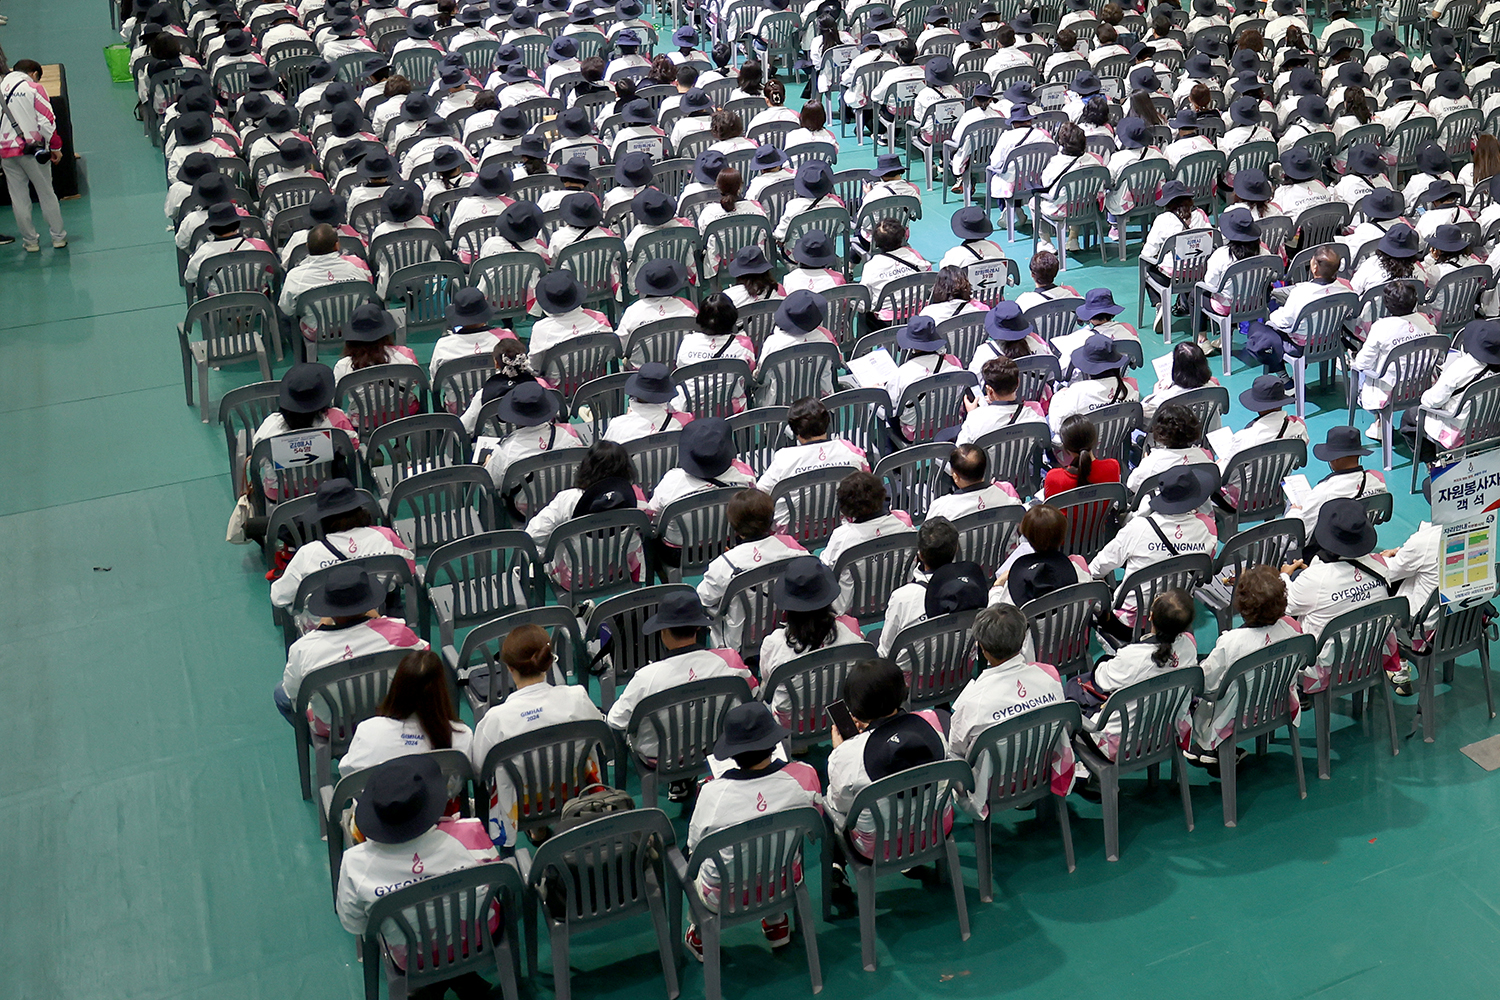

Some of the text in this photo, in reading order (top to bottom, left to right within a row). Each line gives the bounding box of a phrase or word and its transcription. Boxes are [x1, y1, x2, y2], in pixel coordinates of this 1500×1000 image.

[1331, 578, 1388, 602] GYEONGNAM
[1350, 592, 1371, 603] 2024
[992, 692, 1057, 721] GYEONGNAM
[520, 707, 543, 718] GIMHAE
[526, 714, 540, 722] 2024
